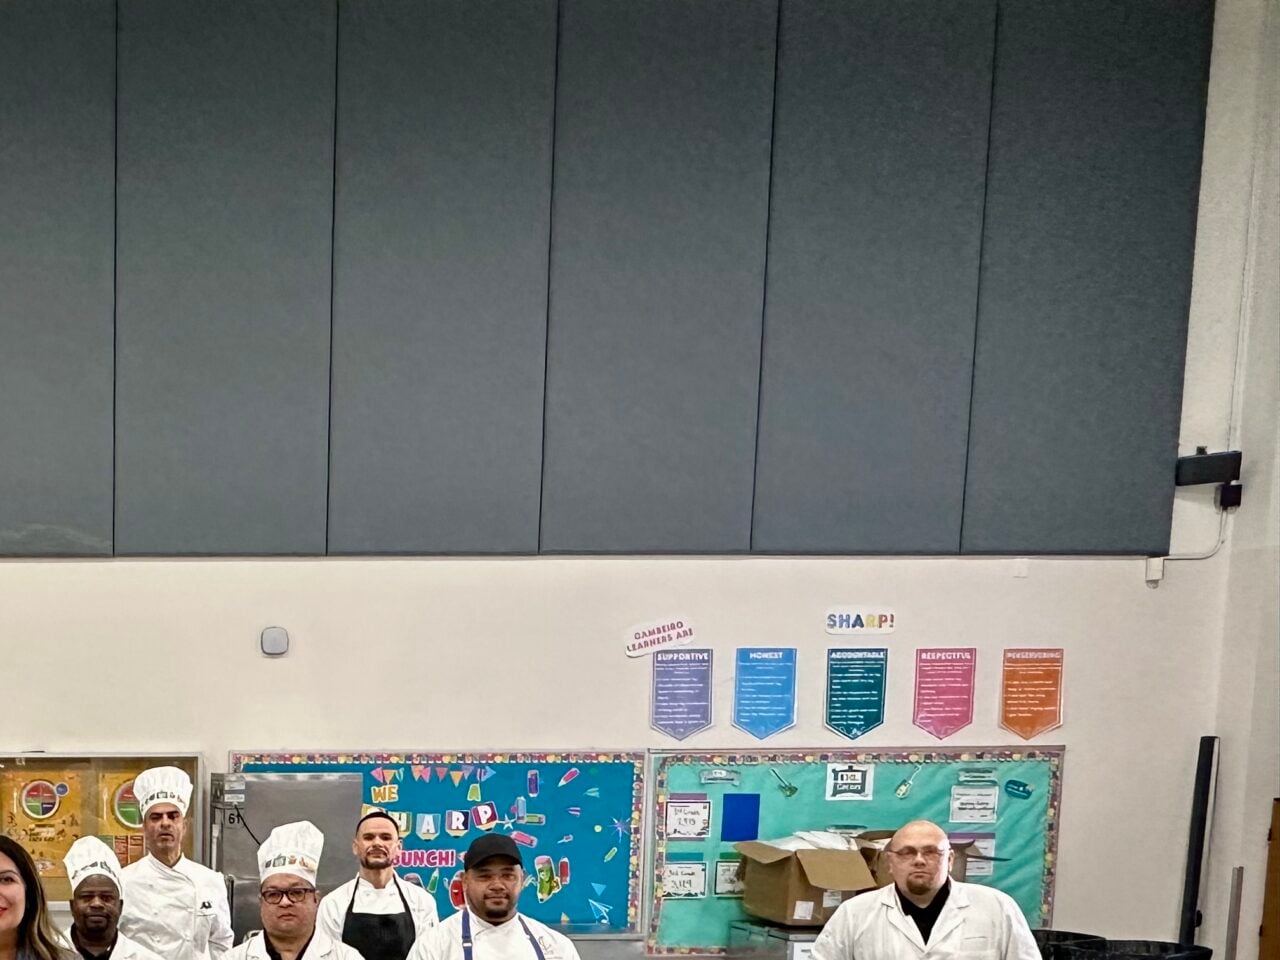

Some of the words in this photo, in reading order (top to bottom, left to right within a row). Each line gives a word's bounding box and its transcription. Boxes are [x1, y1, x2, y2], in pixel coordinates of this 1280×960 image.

[827, 613, 894, 629] SHARP!
[626, 633, 673, 653] LEARNERS
[676, 627, 694, 641] ARE
[657, 652, 709, 661] SUPPORTIVE
[749, 651, 784, 660] HONEST
[831, 651, 885, 660] ACCOUNTABLE
[921, 651, 972, 660] RESPECTFUL
[371, 785, 398, 802] WE
[466, 783, 481, 801] A
[367, 803, 492, 835] HARP
[391, 850, 455, 867] BUNCH!
